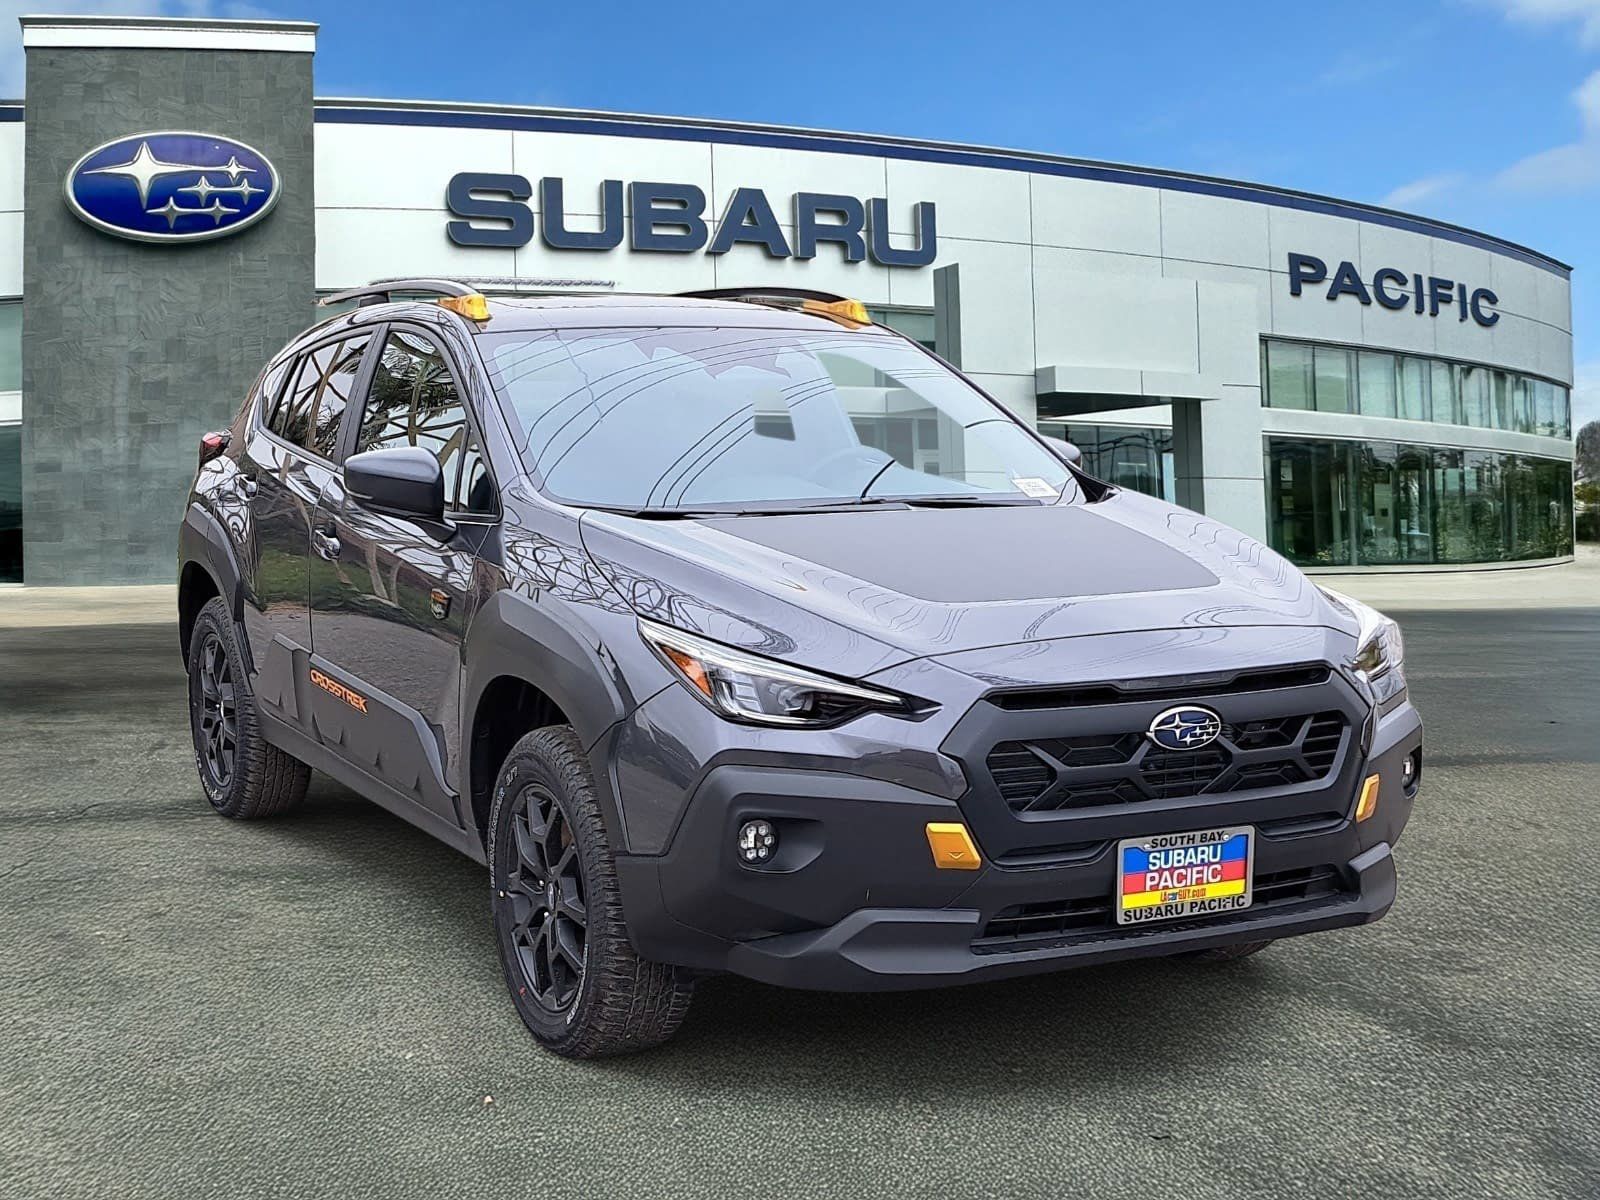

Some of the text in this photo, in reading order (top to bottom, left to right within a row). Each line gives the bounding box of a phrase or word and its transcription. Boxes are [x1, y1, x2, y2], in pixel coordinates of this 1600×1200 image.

[446, 171, 937, 267] SUBARU
[1288, 252, 1500, 327] PACIFIC
[311, 669, 368, 713] CROSSTREK
[1151, 830, 1225, 849] SOUTH BAY
[1148, 844, 1222, 871] SUBARU
[1145, 864, 1222, 892] PACIFIC
[1123, 895, 1246, 923] SUBARU PACIFIC
